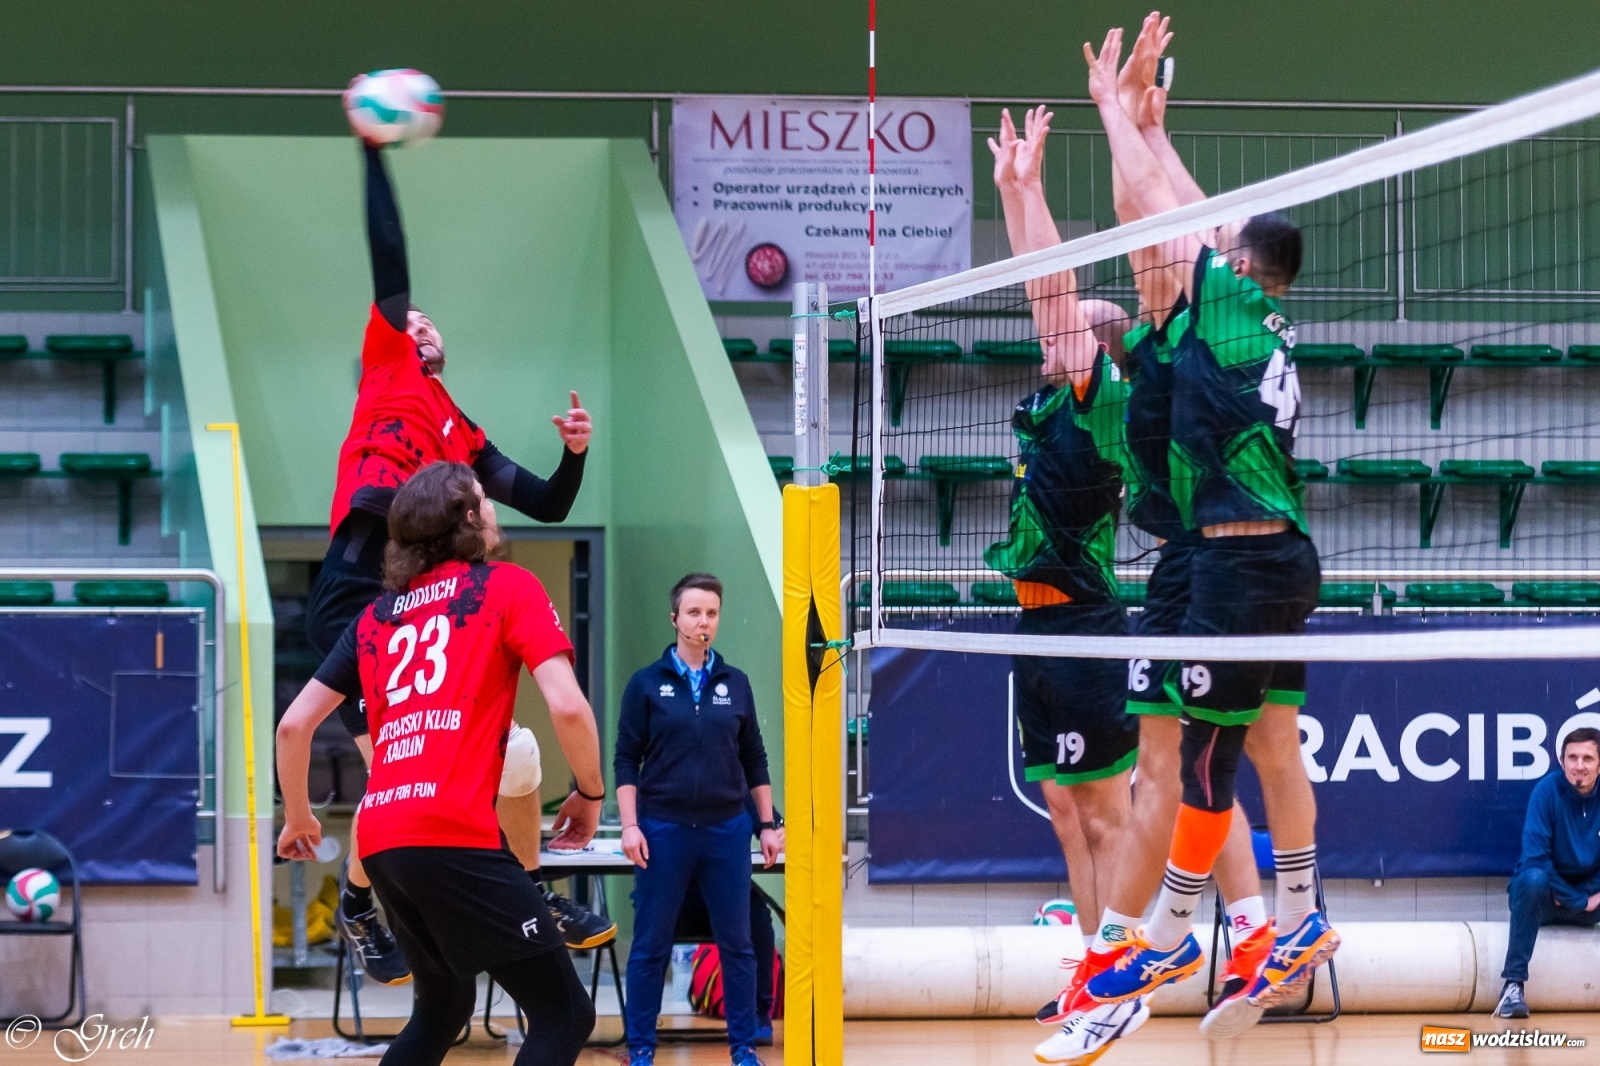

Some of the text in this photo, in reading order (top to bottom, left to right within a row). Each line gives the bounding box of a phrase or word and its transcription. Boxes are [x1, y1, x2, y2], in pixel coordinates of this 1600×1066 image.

[710, 109, 935, 154] MIESZKO
[713, 181, 781, 196] Operator
[786, 182, 856, 197] urządzeń
[713, 198, 892, 214] Pracownik produkcyny
[878, 227, 897, 238] na
[392, 577, 458, 616] BODUCH
[386, 614, 451, 707] 23
[1128, 658, 1152, 692] 16
[424, 709, 462, 731] KLUB
[1056, 731, 1086, 765] 19
[364, 782, 437, 809] WE PLAY FOR FUN
